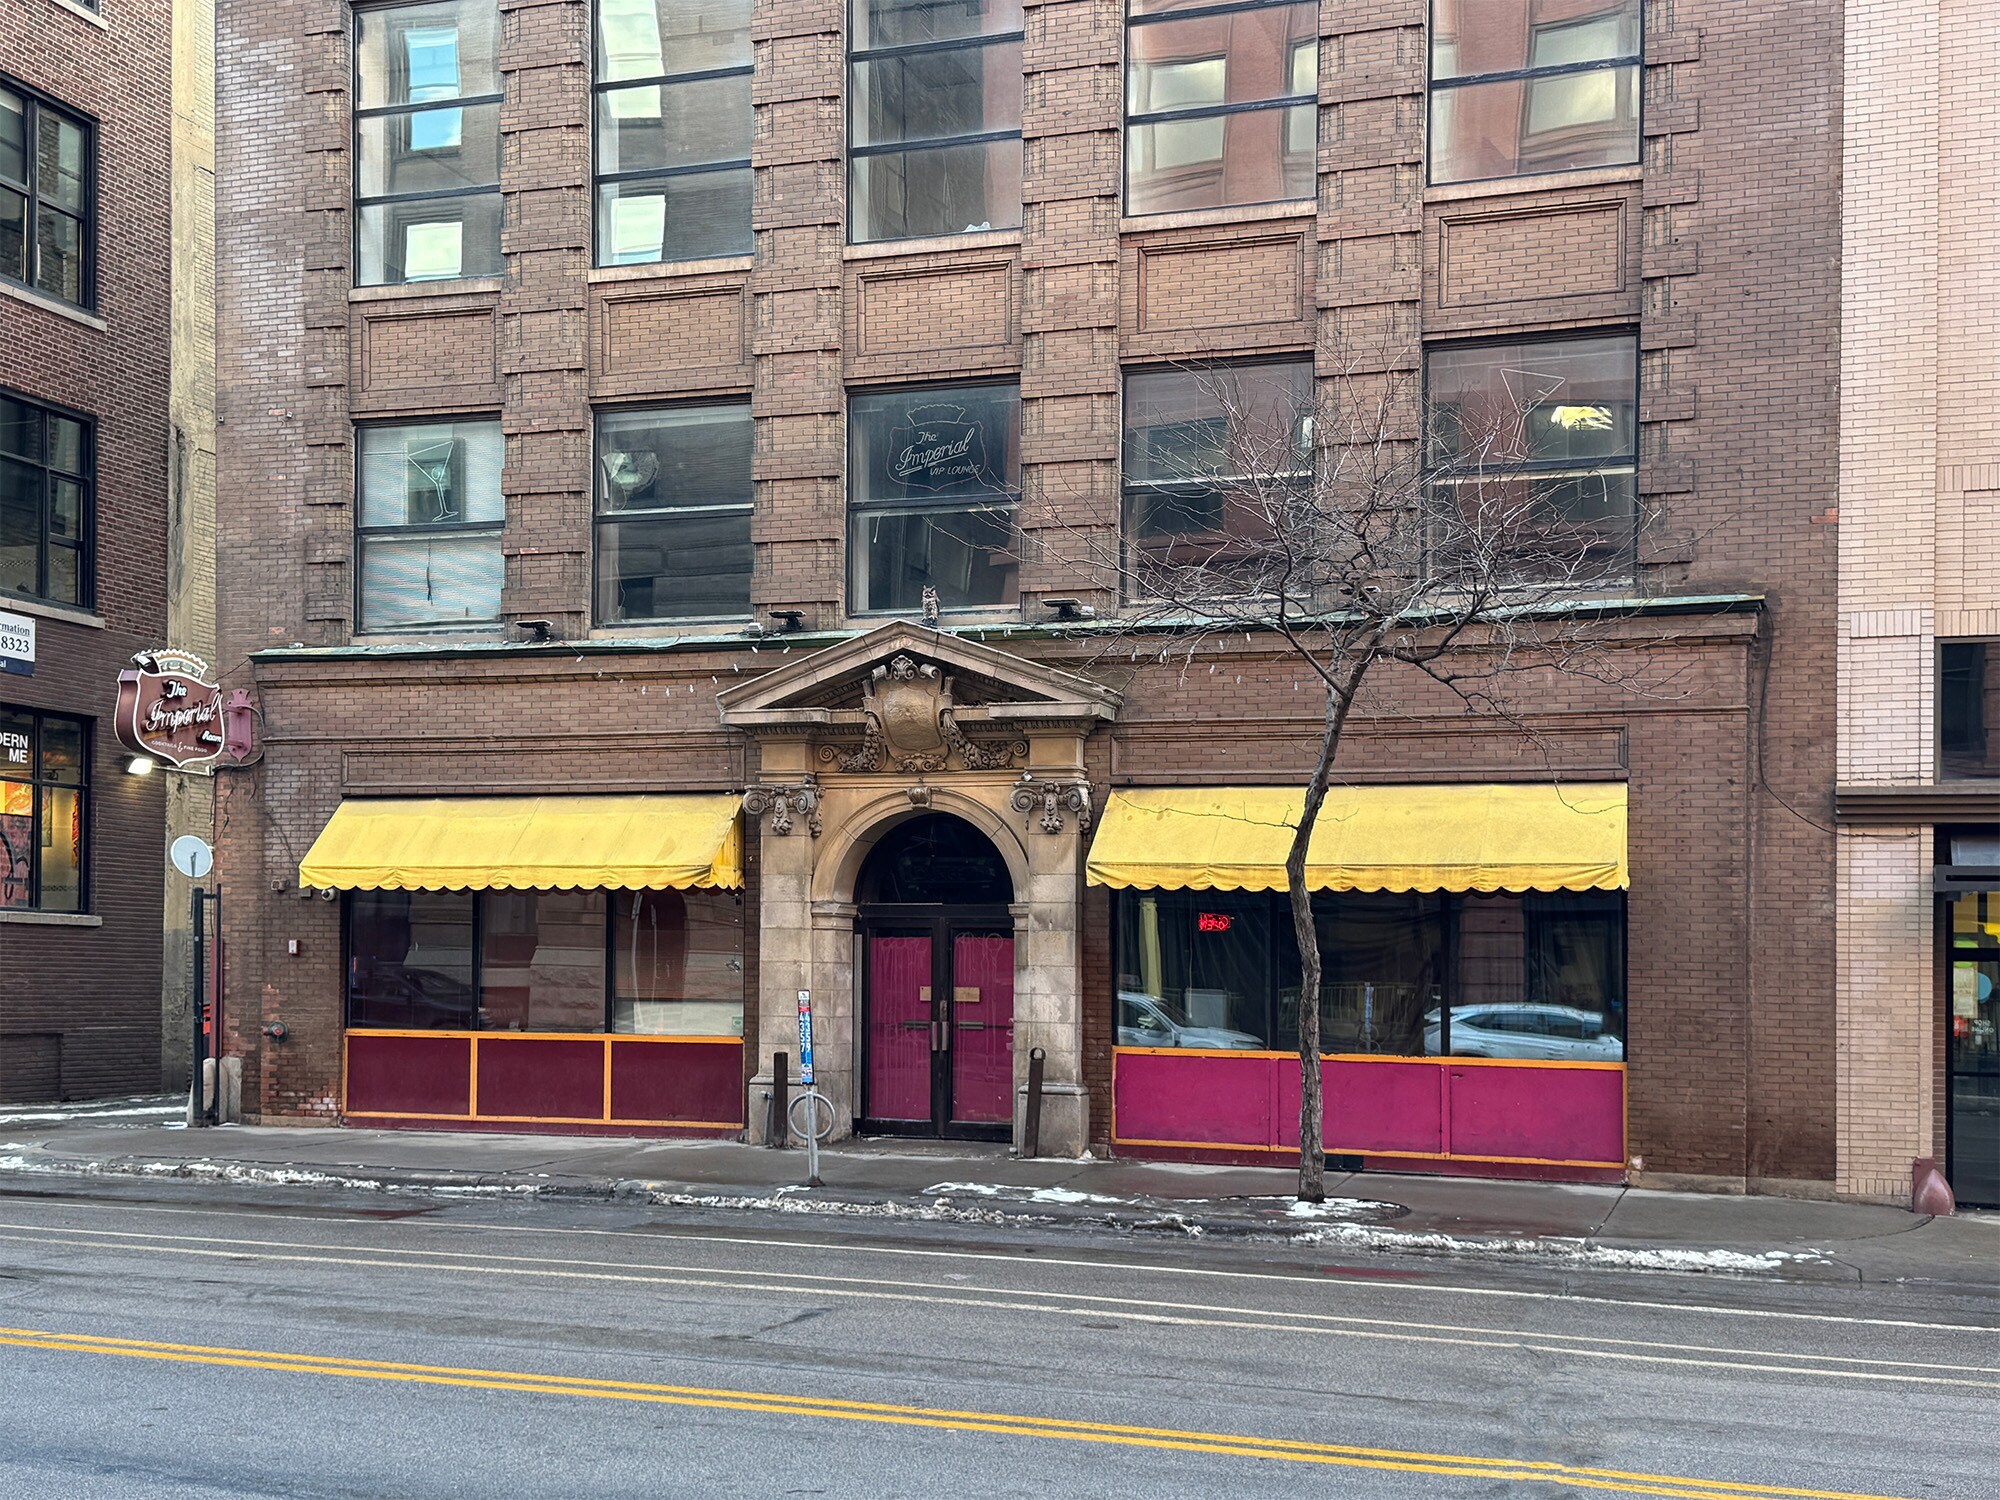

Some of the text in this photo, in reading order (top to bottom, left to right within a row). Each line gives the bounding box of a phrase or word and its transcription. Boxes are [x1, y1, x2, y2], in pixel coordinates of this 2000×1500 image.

[916, 431, 938, 444] The
[895, 427, 975, 470] Imperial
[930, 465, 980, 476] VIP LOUNGE
[1, 636, 30, 653] 8323
[167, 681, 187, 698] The
[146, 692, 220, 733] Imperial
[202, 730, 222, 743] Room
[9, 748, 28, 763] ME
